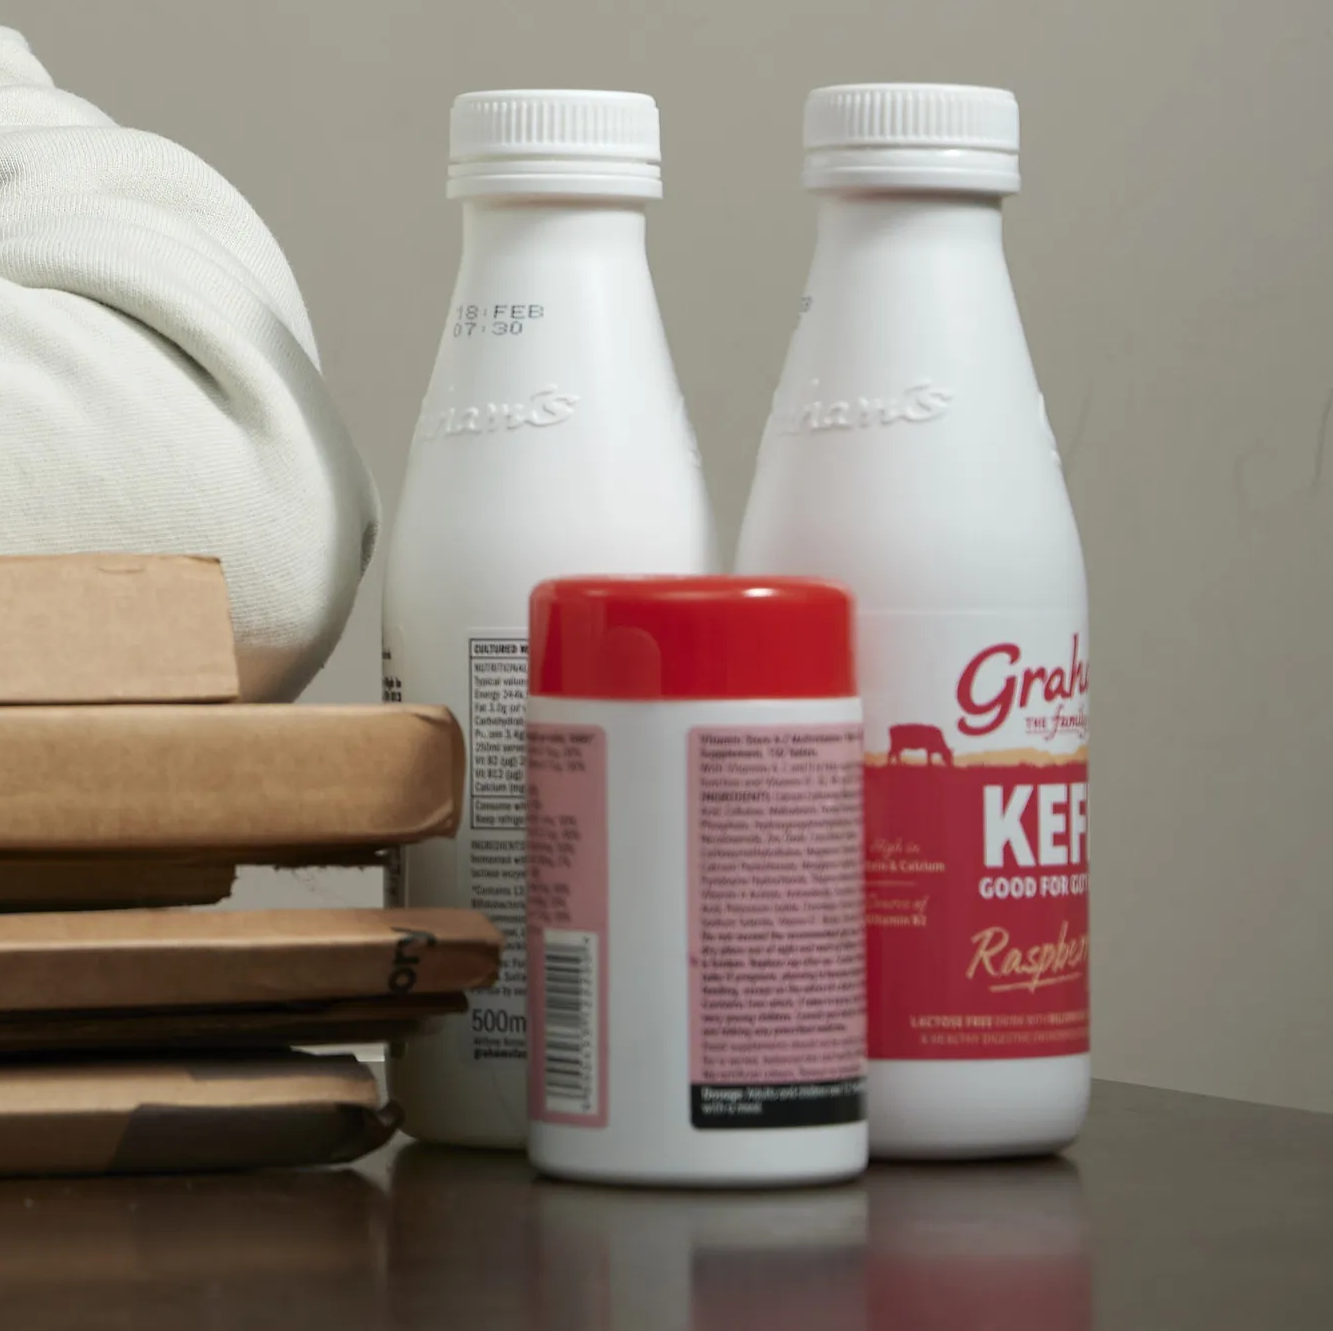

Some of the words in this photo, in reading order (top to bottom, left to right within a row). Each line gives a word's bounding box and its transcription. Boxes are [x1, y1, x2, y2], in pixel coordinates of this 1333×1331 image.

[452, 321, 523, 338] 07:30
[979, 876, 1037, 900] GOOD
[1040, 875, 1069, 898] FOR
